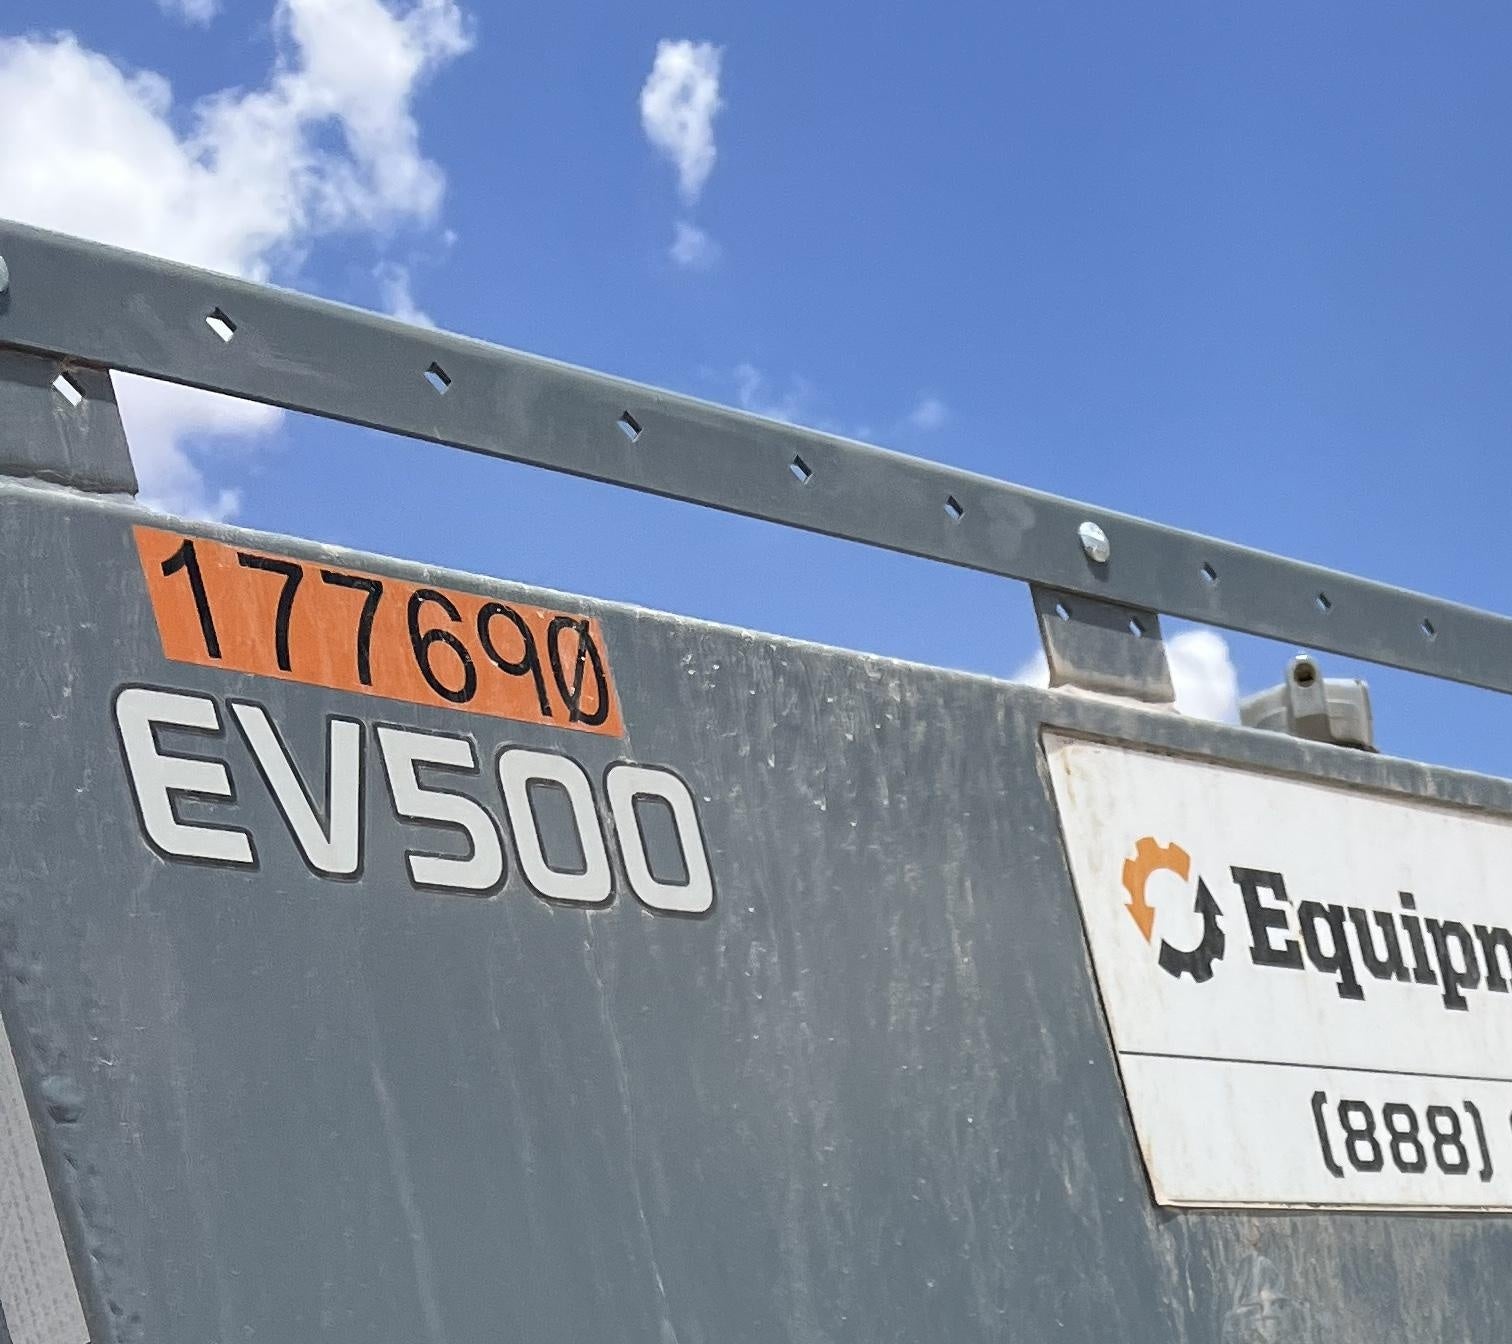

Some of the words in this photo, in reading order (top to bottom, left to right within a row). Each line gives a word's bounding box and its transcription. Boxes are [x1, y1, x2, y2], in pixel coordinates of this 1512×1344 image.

[159, 539, 609, 728] 177690
[112, 684, 716, 918] EV500
[1311, 1090, 1493, 1182] (888)
